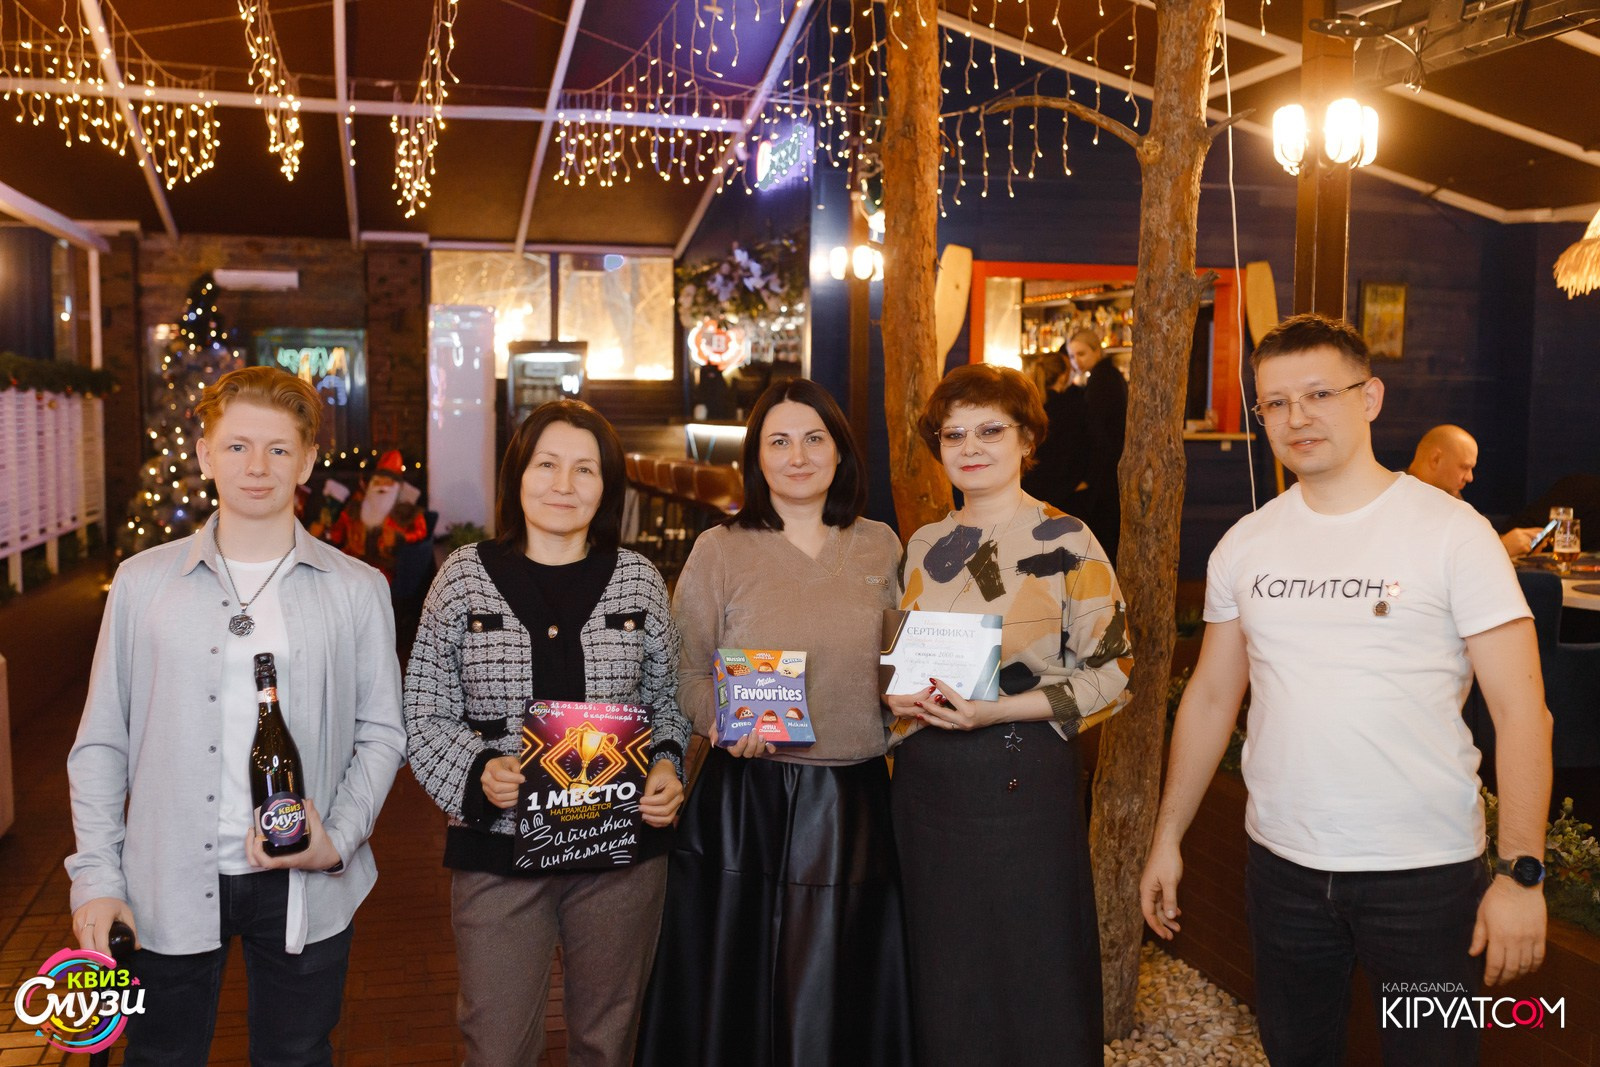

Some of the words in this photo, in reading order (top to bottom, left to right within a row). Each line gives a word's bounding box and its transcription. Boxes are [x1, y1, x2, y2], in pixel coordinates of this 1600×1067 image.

[1250, 573, 1385, 599] Капитан
[906, 626, 976, 638] СЕРТИФИКАТ
[755, 677, 776, 687] Milka
[733, 685, 803, 702] Favourites
[731, 721, 752, 729] OREO
[527, 792, 541, 811] 1
[545, 781, 637, 810] МЕСТО
[278, 802, 302, 815] КВИЗ
[550, 803, 612, 816] НАГРАЖДАЕТСЯ
[261, 809, 306, 831] Смузи
[560, 812, 600, 822] КОМАНДА
[540, 832, 637, 869] интеллекта
